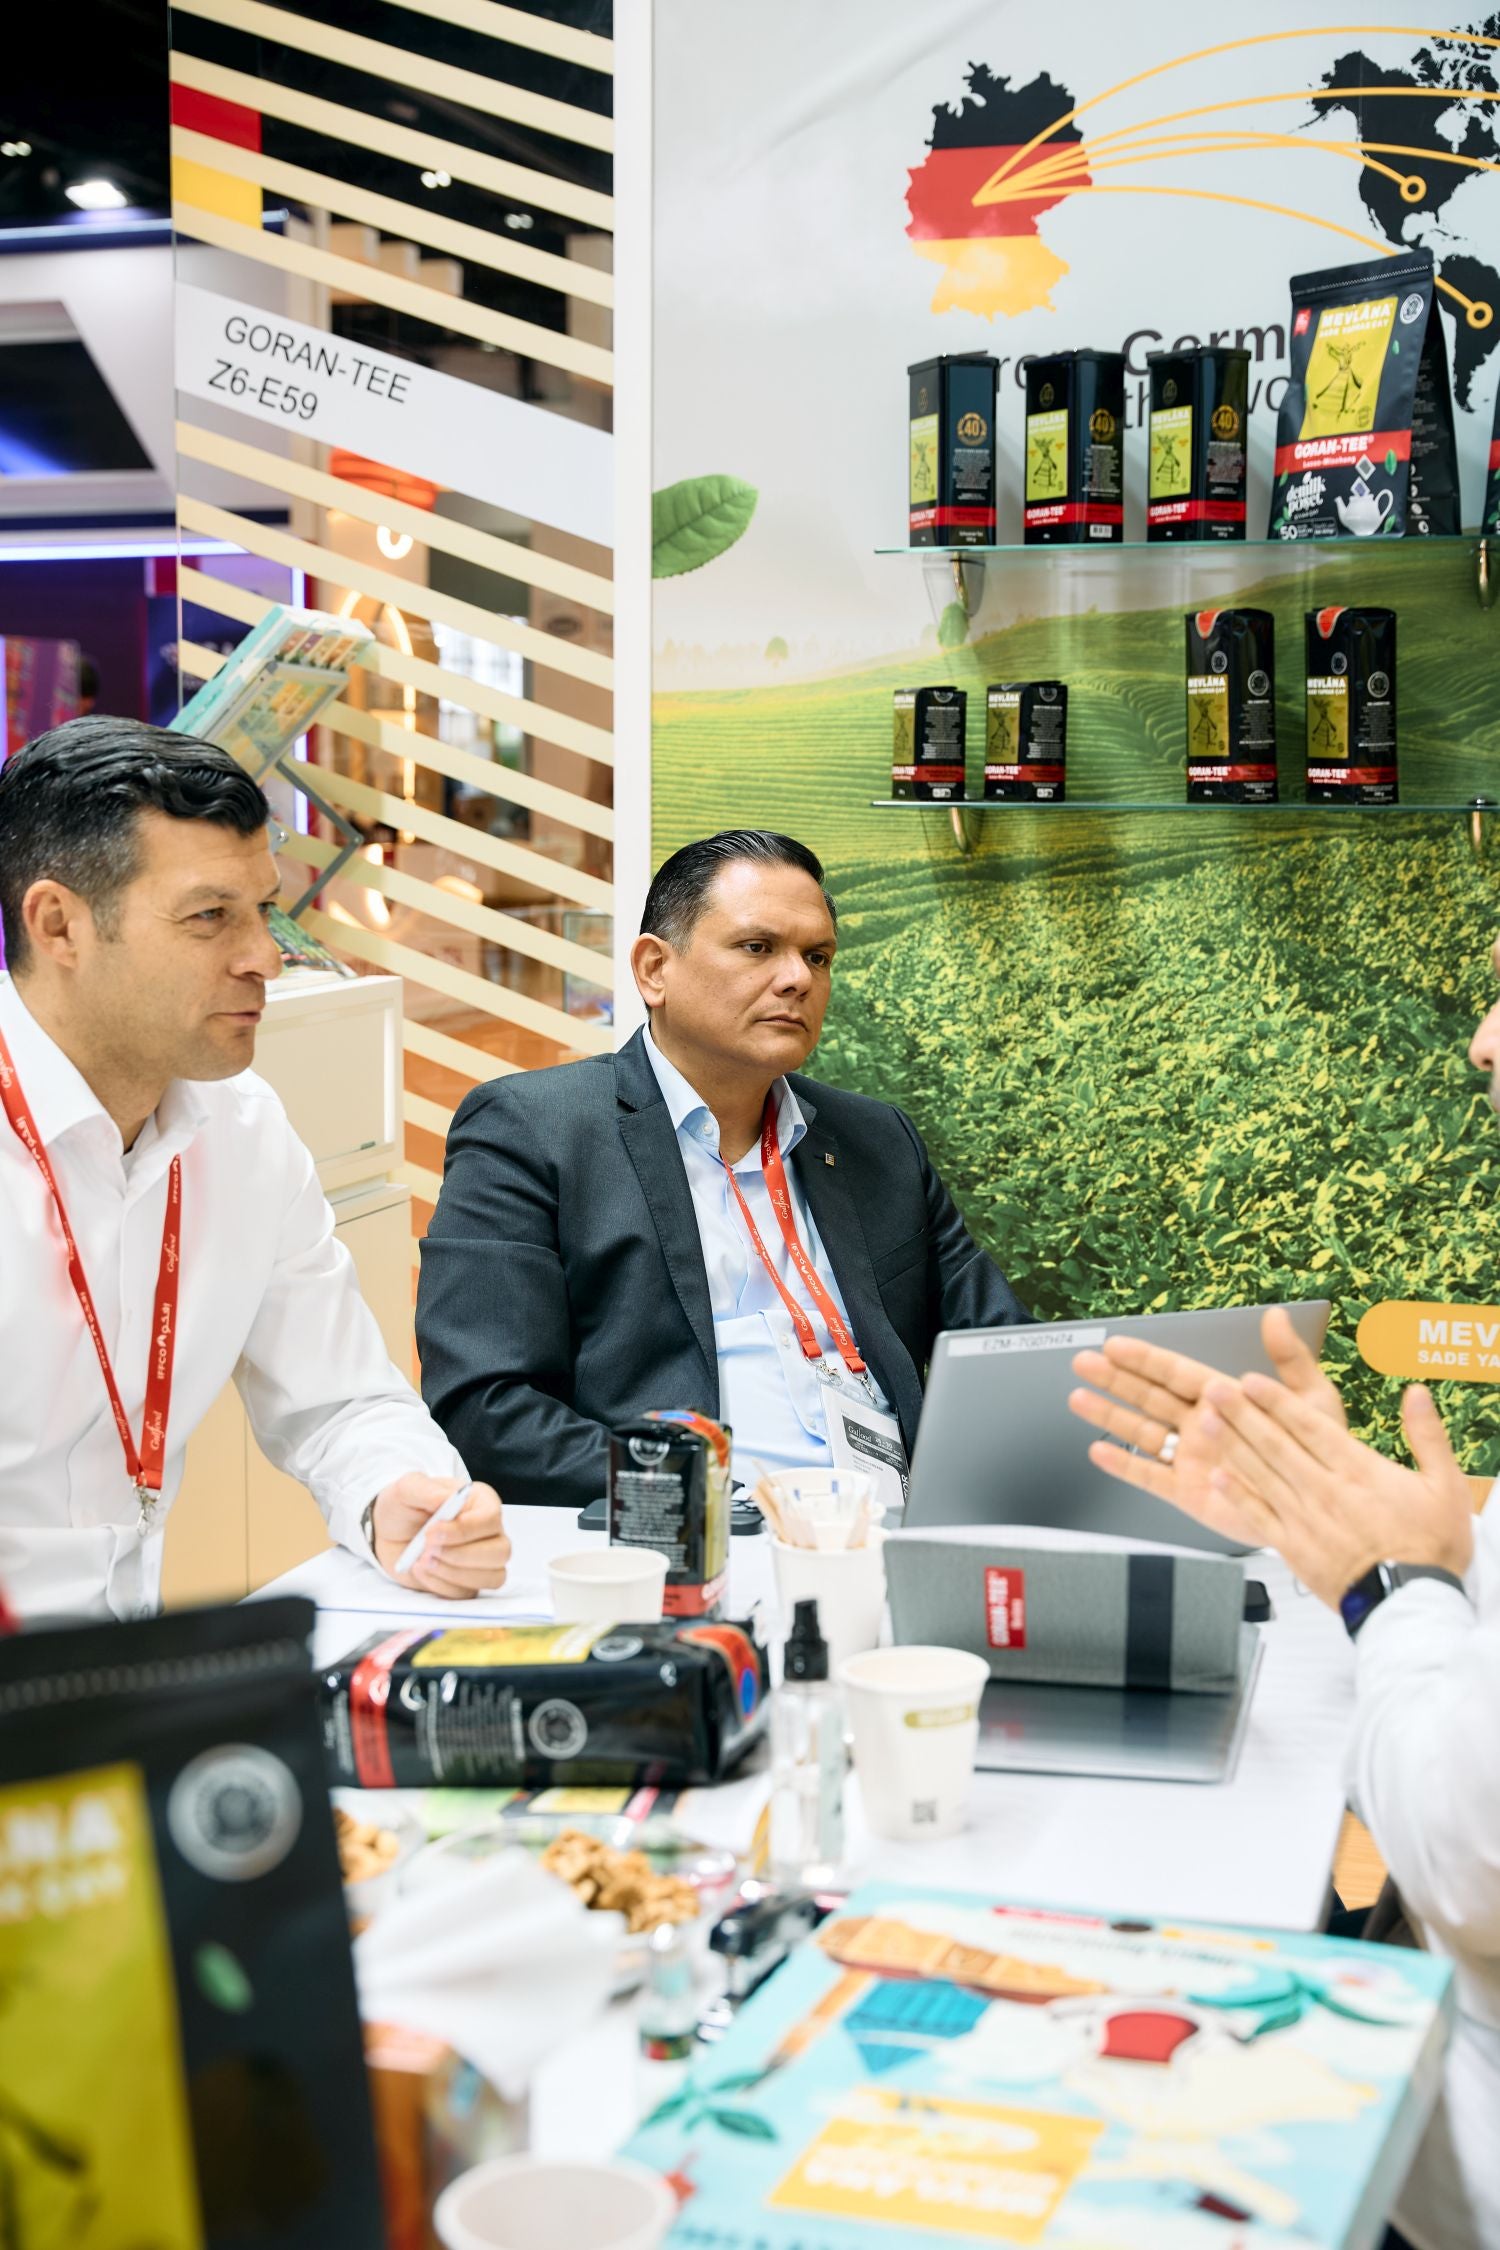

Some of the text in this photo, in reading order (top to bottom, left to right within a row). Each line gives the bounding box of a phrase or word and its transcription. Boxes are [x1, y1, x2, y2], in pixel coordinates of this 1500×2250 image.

[224, 316, 411, 403] GORAN-TEE
[208, 359, 318, 420] Z6-E59
[1280, 525, 1298, 540] 50
[1419, 1318, 1500, 1348] MEV
[156, 1348, 167, 1380] IFFCO
[1417, 1349, 1500, 1369] SADE YA
[145, 1410, 166, 1451] Gulfood
